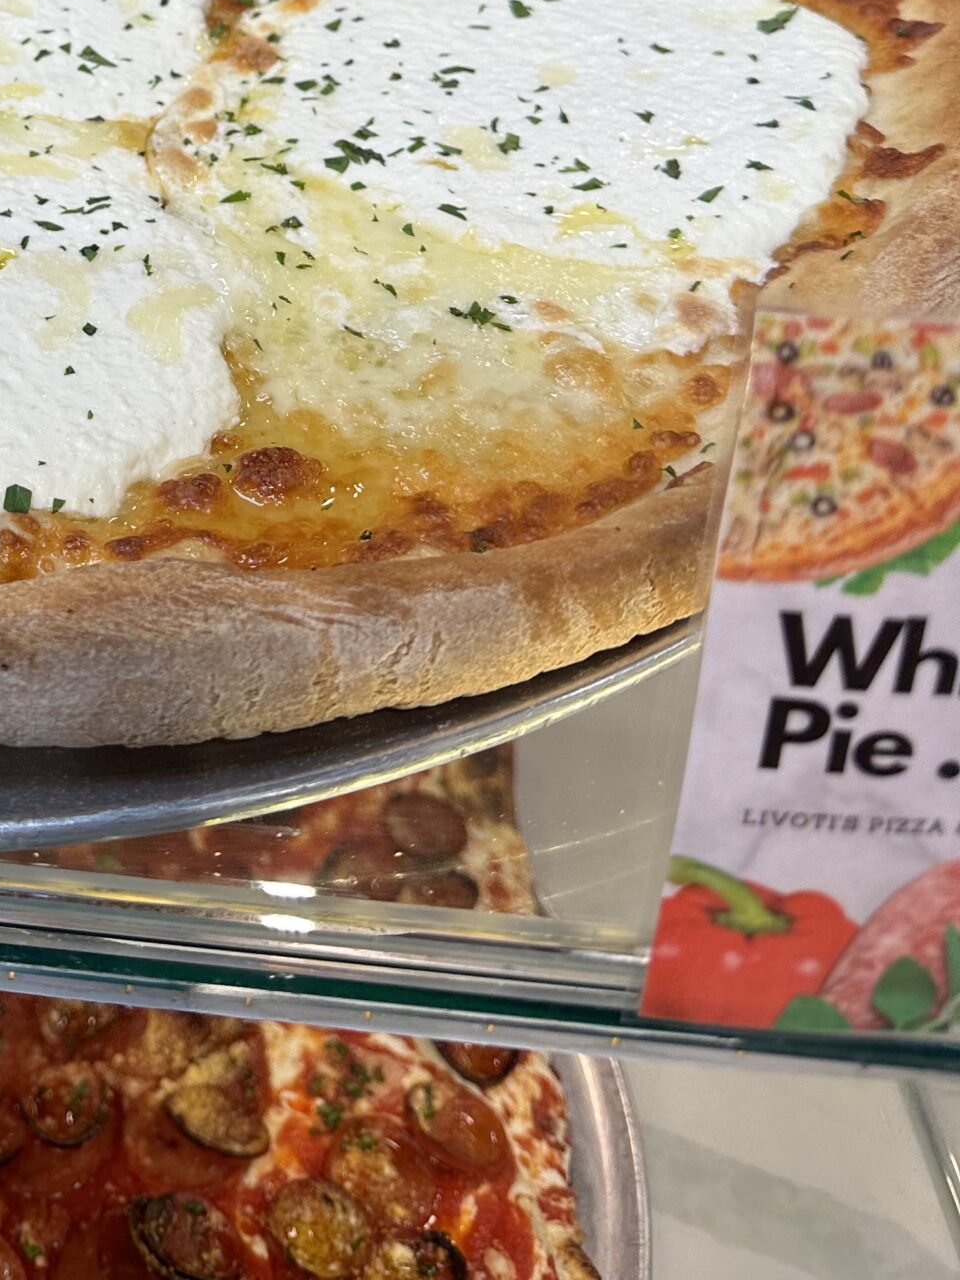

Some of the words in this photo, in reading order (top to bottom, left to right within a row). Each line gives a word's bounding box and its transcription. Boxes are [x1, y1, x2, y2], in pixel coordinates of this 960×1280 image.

[780, 610, 960, 695] Wh
[759, 696, 913, 776] Pie
[868, 816, 944, 836] PIZZA
